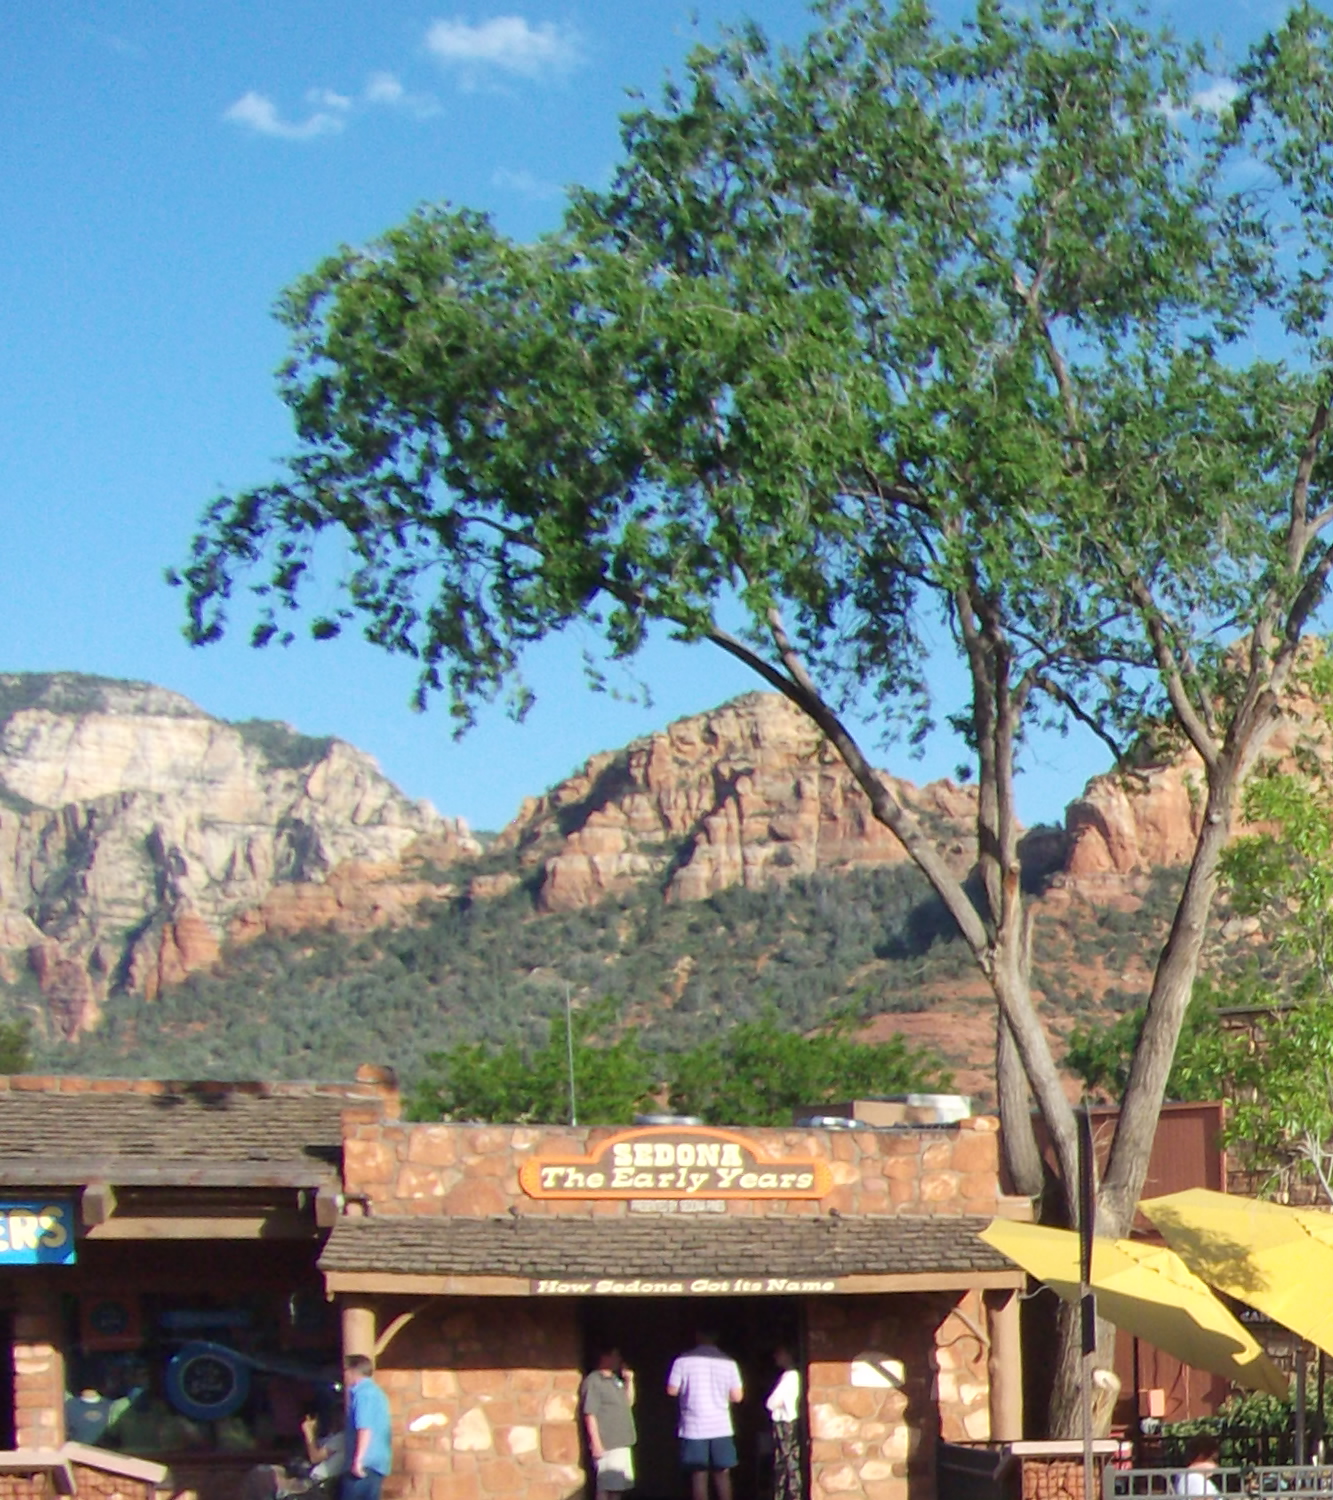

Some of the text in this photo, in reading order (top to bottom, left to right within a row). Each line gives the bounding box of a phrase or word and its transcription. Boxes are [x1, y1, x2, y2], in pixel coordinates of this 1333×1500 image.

[613, 1143, 743, 1167] SEDONA
[541, 1167, 814, 1192] The Early Years
[537, 1280, 592, 1293] How
[595, 1280, 683, 1293] Sedona
[690, 1280, 730, 1292] Got
[766, 1279, 835, 1292] Name
